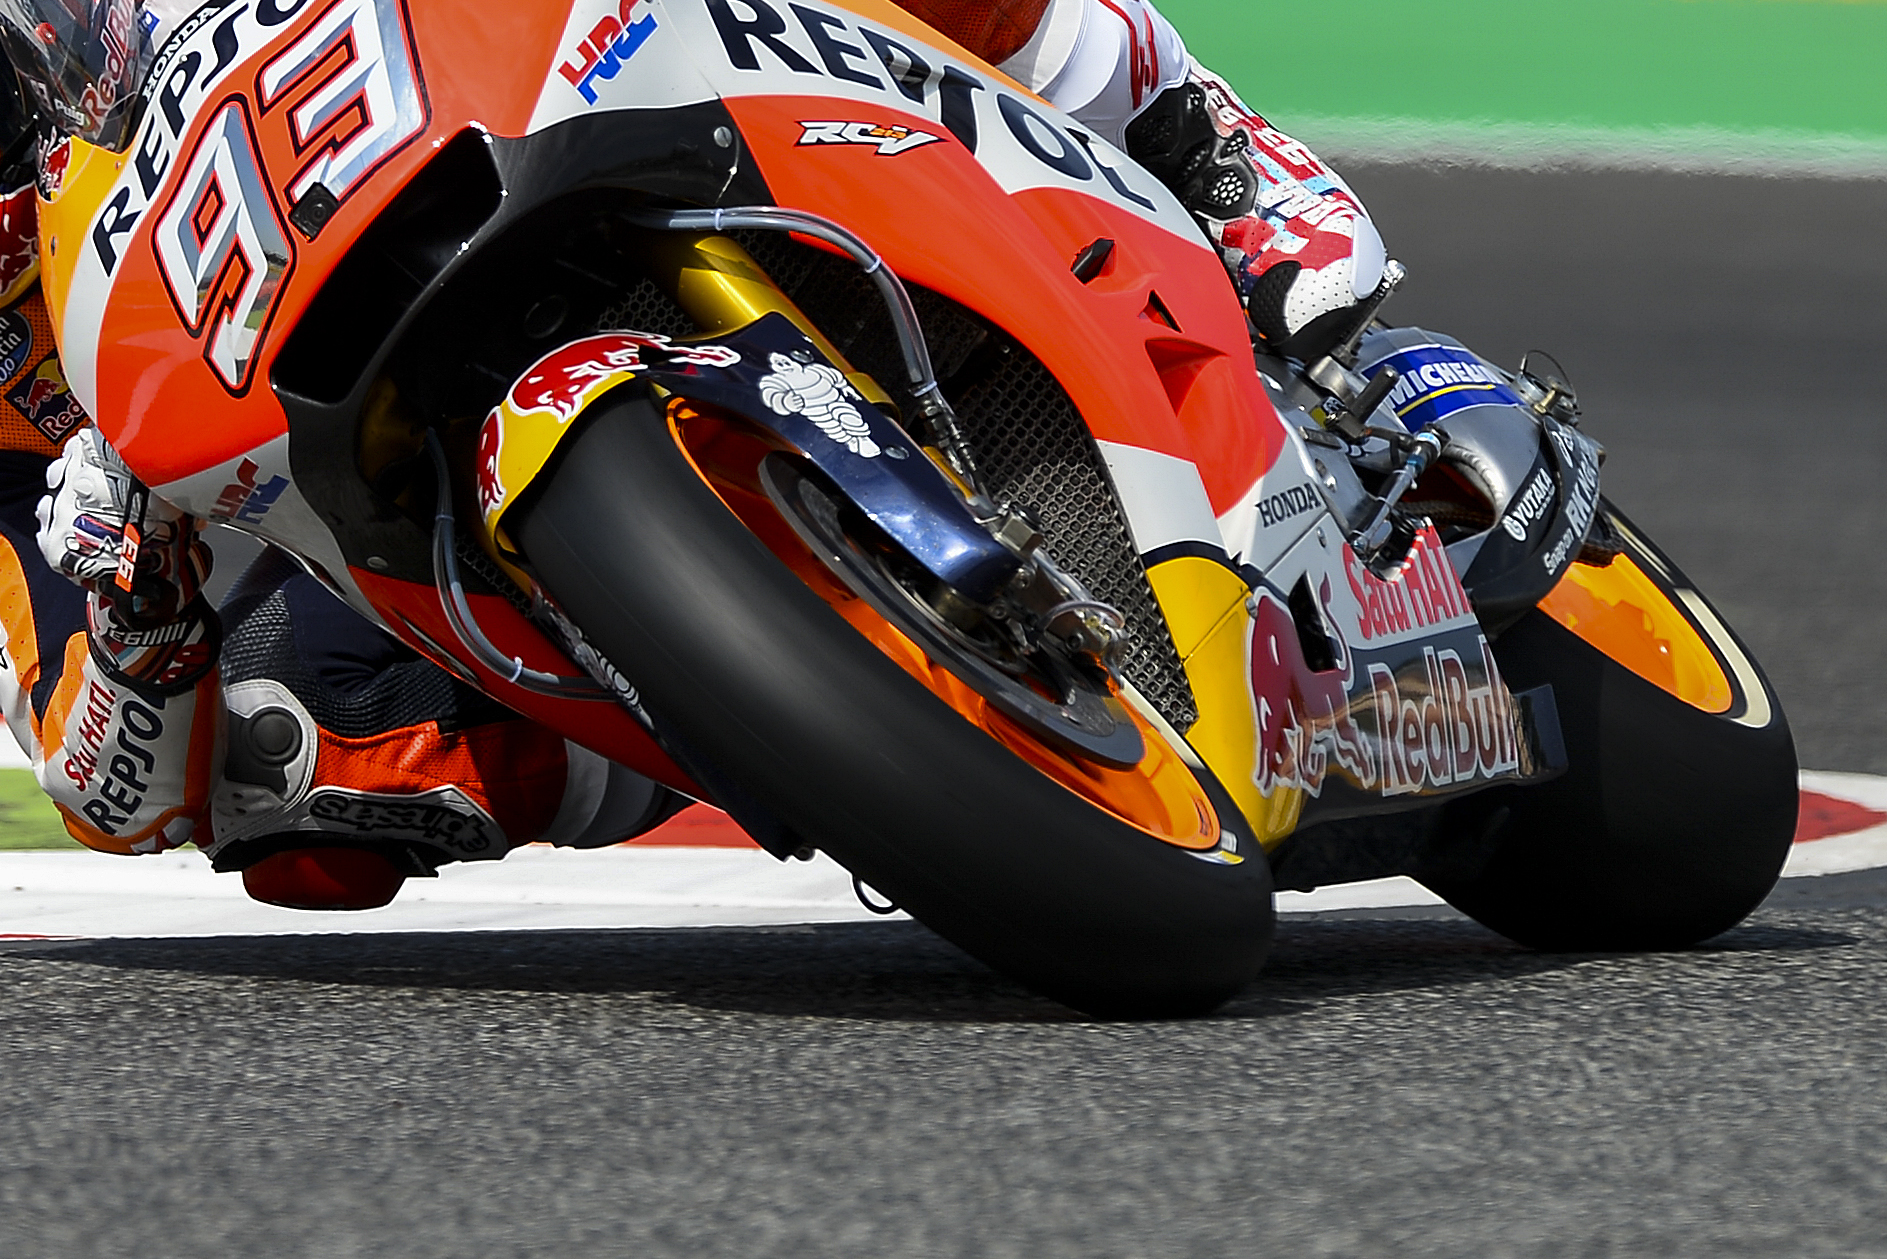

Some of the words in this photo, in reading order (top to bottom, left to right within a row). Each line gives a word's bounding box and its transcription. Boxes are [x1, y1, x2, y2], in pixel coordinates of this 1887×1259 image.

[142, 6, 221, 102] HONDA
[38, 393, 85, 440] Red
[1255, 481, 1321, 529] HONDA
[1513, 468, 1554, 527] YUTAKA
